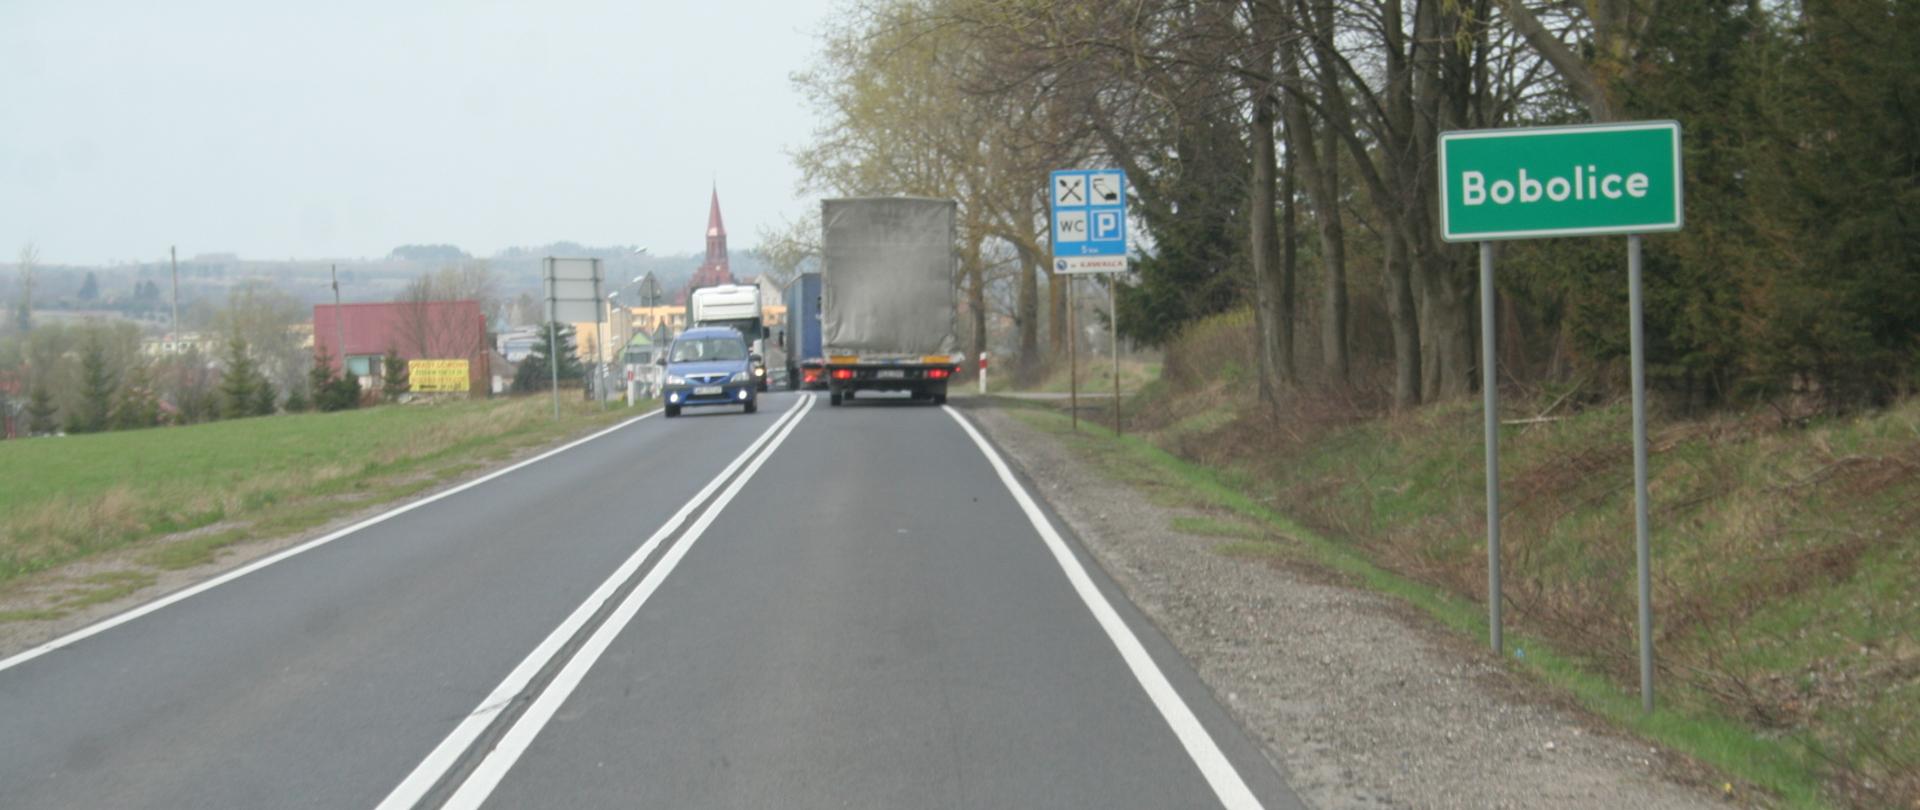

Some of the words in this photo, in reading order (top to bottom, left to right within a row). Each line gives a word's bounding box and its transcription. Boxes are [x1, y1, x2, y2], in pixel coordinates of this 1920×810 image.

[1462, 165, 1649, 206] Bobolice
[1060, 220, 1084, 232] WC
[1098, 212, 1116, 238] P
